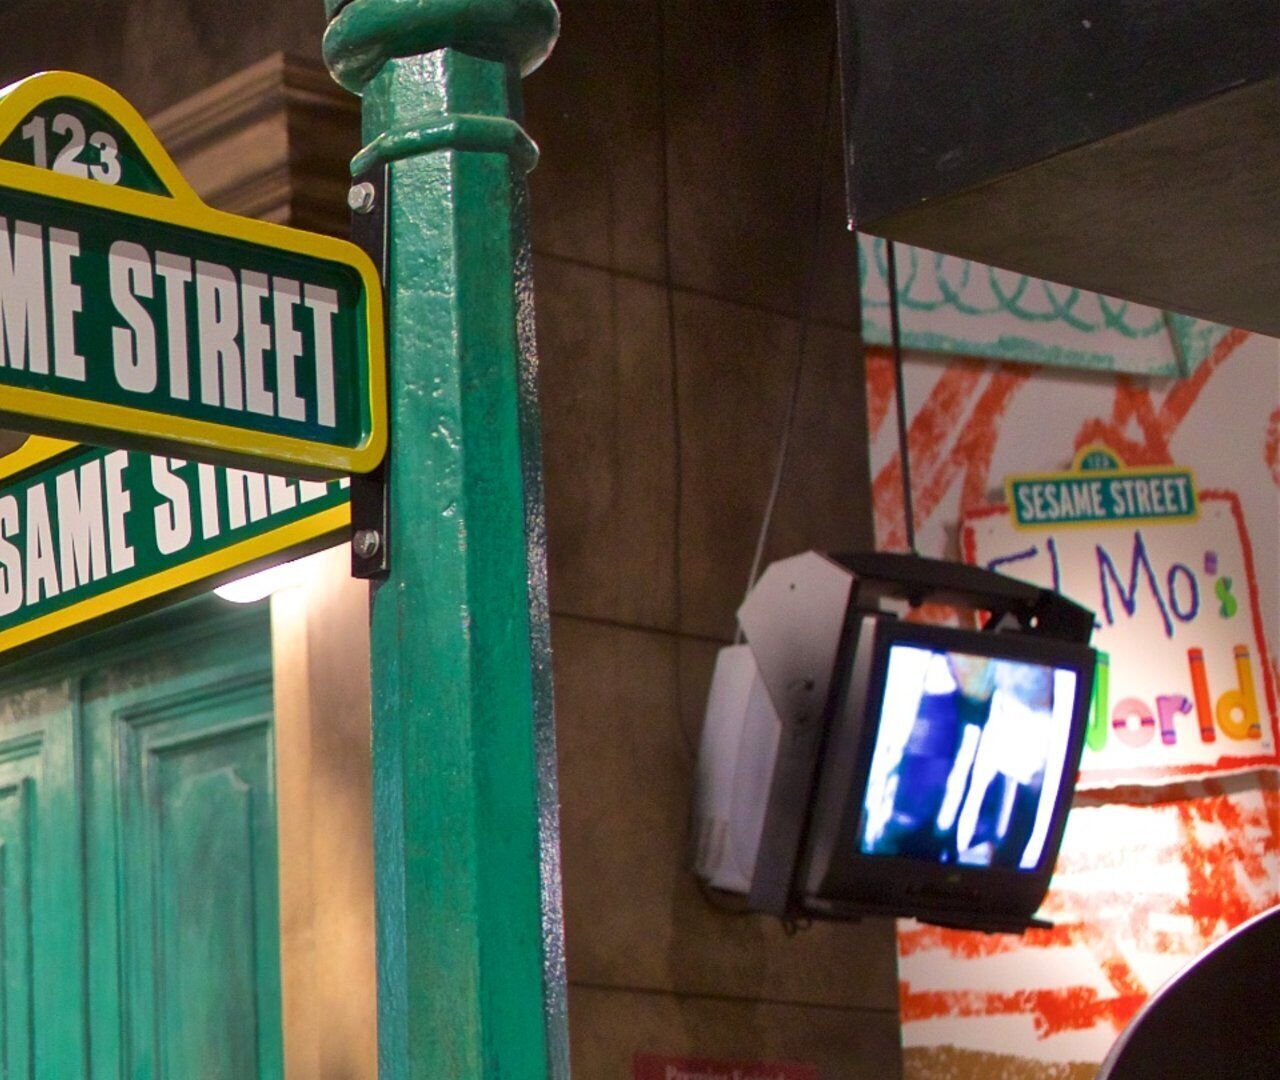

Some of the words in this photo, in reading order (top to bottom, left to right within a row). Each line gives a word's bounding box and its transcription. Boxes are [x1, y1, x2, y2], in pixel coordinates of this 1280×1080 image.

[21, 112, 122, 185] 123
[108, 240, 340, 428] STREET
[150, 454, 351, 555] STR
[1017, 480, 1107, 521] SESAME
[1110, 477, 1189, 515] STREET
